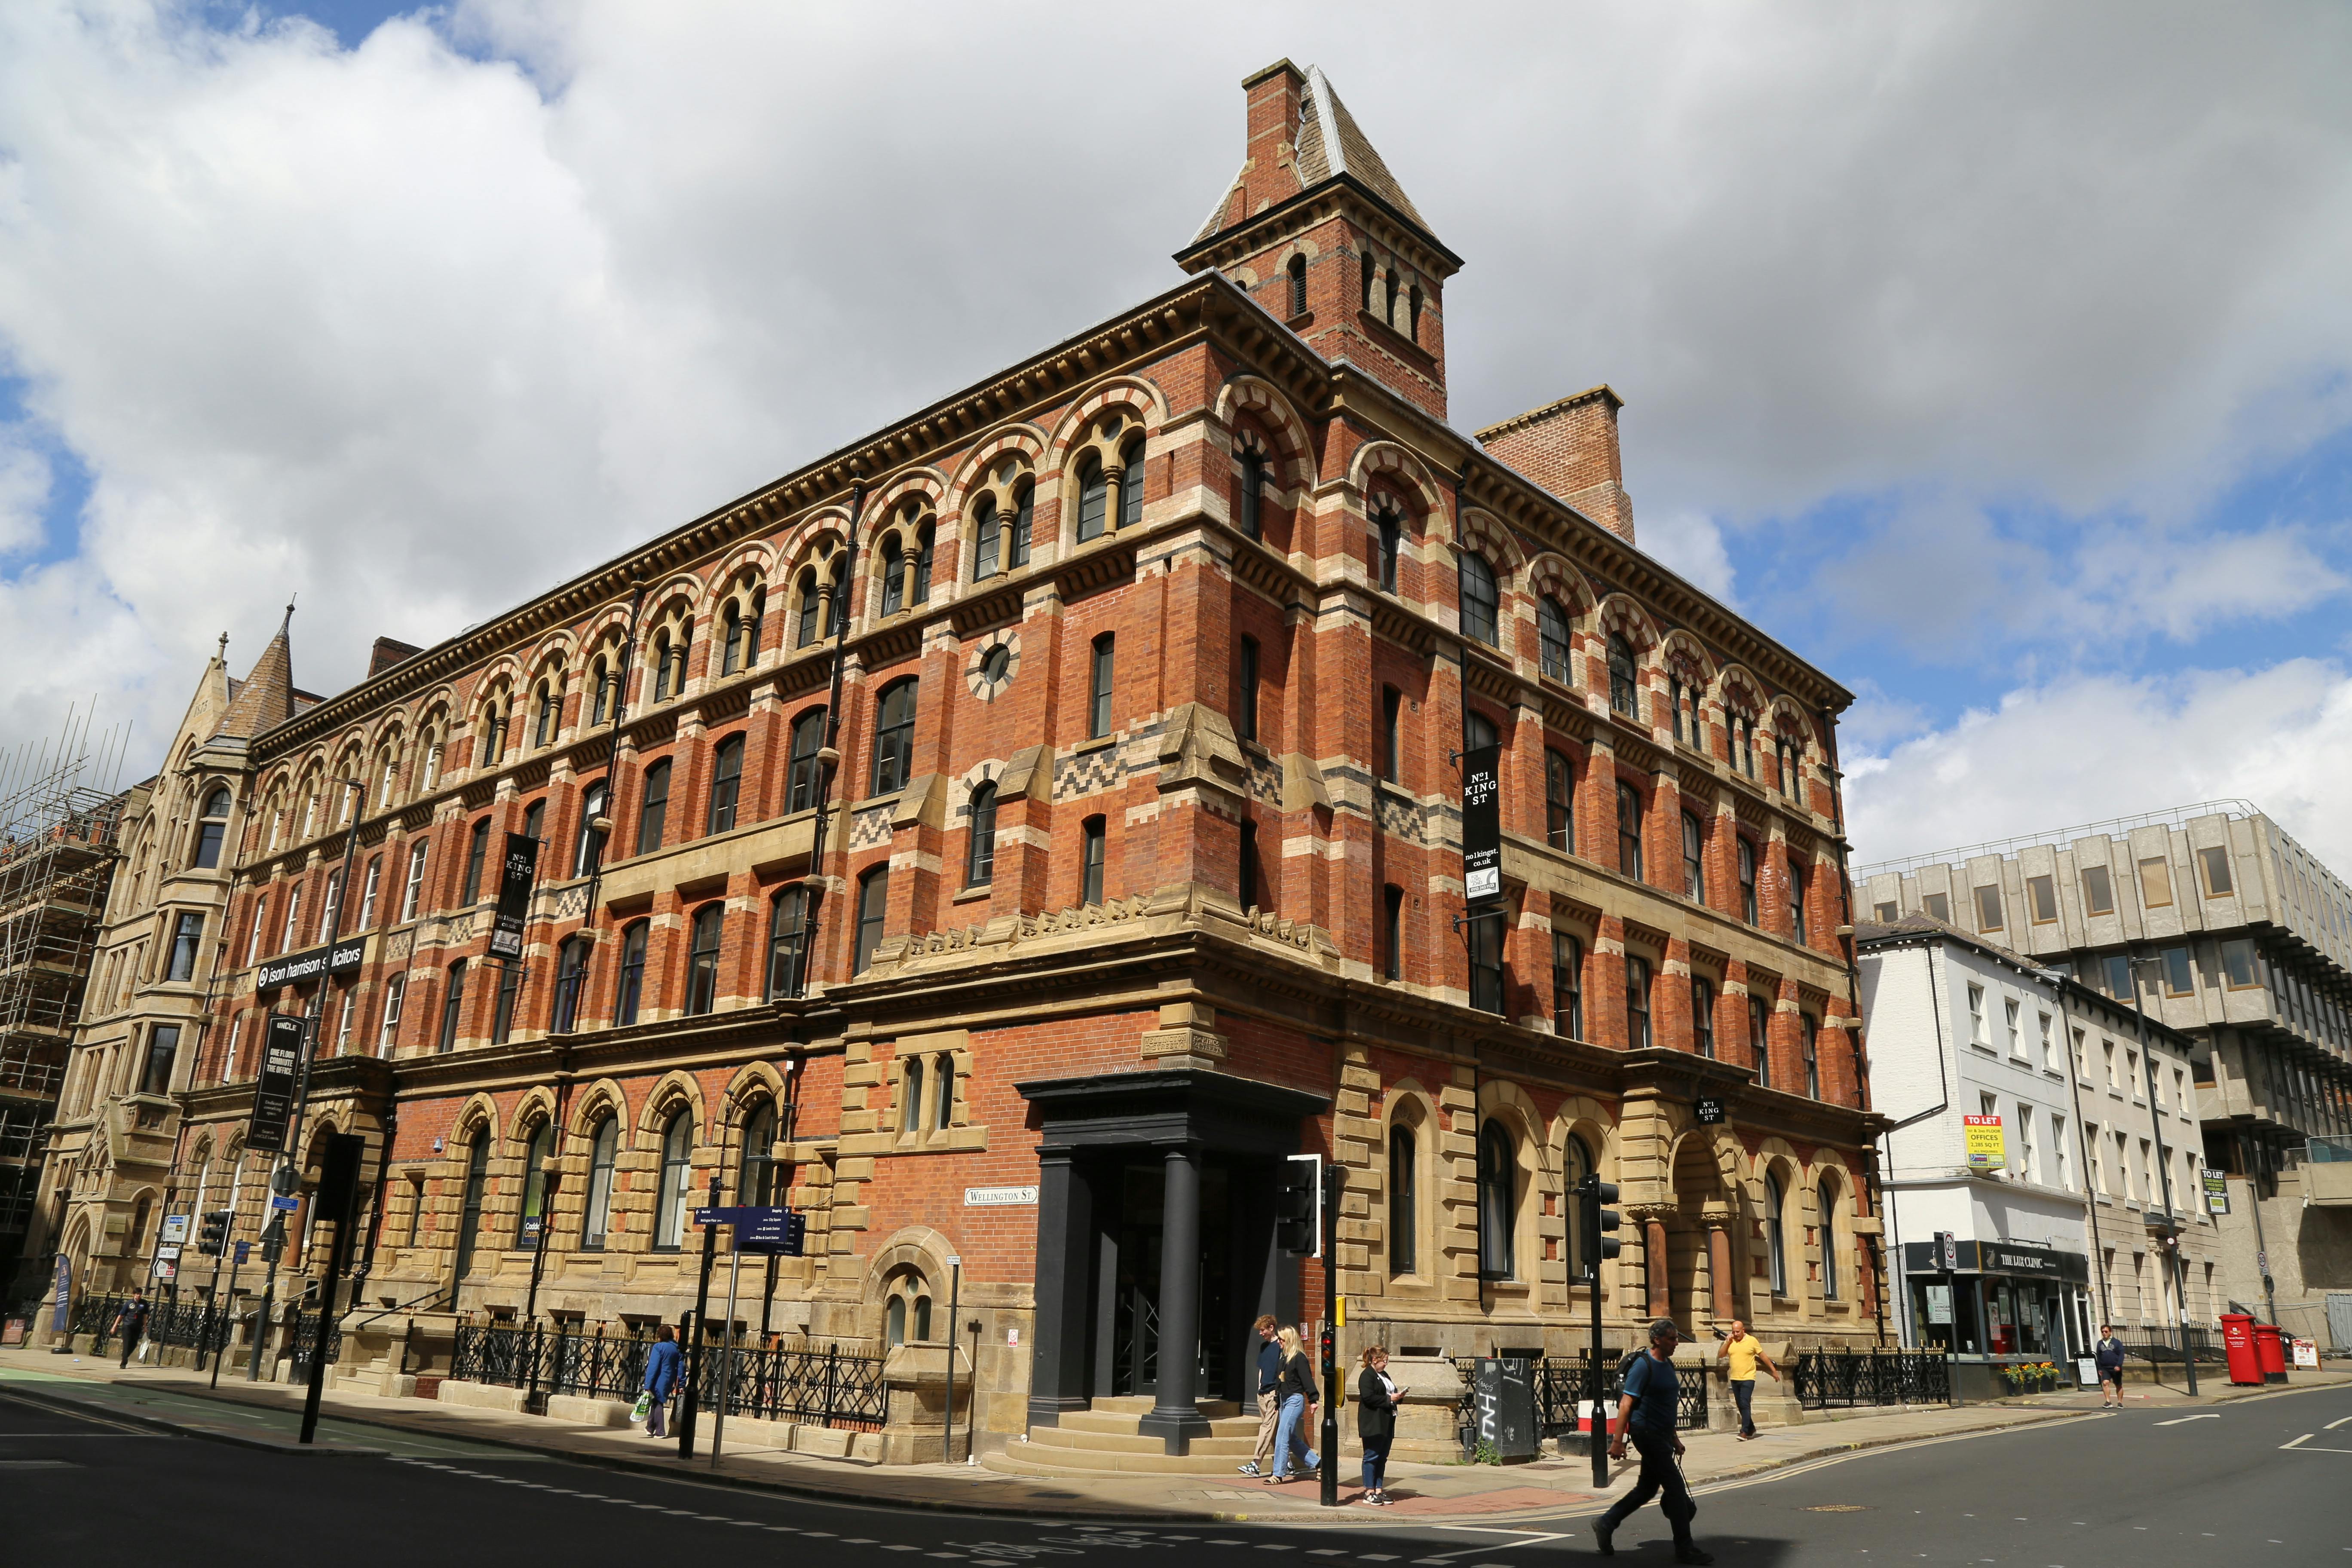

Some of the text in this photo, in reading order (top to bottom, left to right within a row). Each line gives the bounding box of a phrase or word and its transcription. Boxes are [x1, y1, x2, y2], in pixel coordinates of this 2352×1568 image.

[1464, 780, 1497, 796] KING
[1472, 793, 1488, 805] ST
[1465, 848, 1498, 861] no1kingst.
[505, 861, 532, 874] KING
[1473, 858, 1491, 867] co.uk
[511, 872, 523, 880] ST
[269, 967, 286, 983] ison
[286, 959, 320, 978] harrison
[322, 948, 361, 970] slicitors
[277, 1022, 297, 1031] UNCLE
[270, 1048, 295, 1059] ONE FLOOR
[270, 1057, 293, 1067] COMMUTE
[267, 1064, 276, 1073] THE
[2202, 1170, 2212, 1178] TO
[971, 1191, 1019, 1201] WELLINGTON
[1947, 1241, 1953, 1251] 20
[2001, 1254, 2013, 1265] THE
[2013, 1256, 2025, 1267] LUX
[2024, 1257, 2043, 1268] CLINIC
